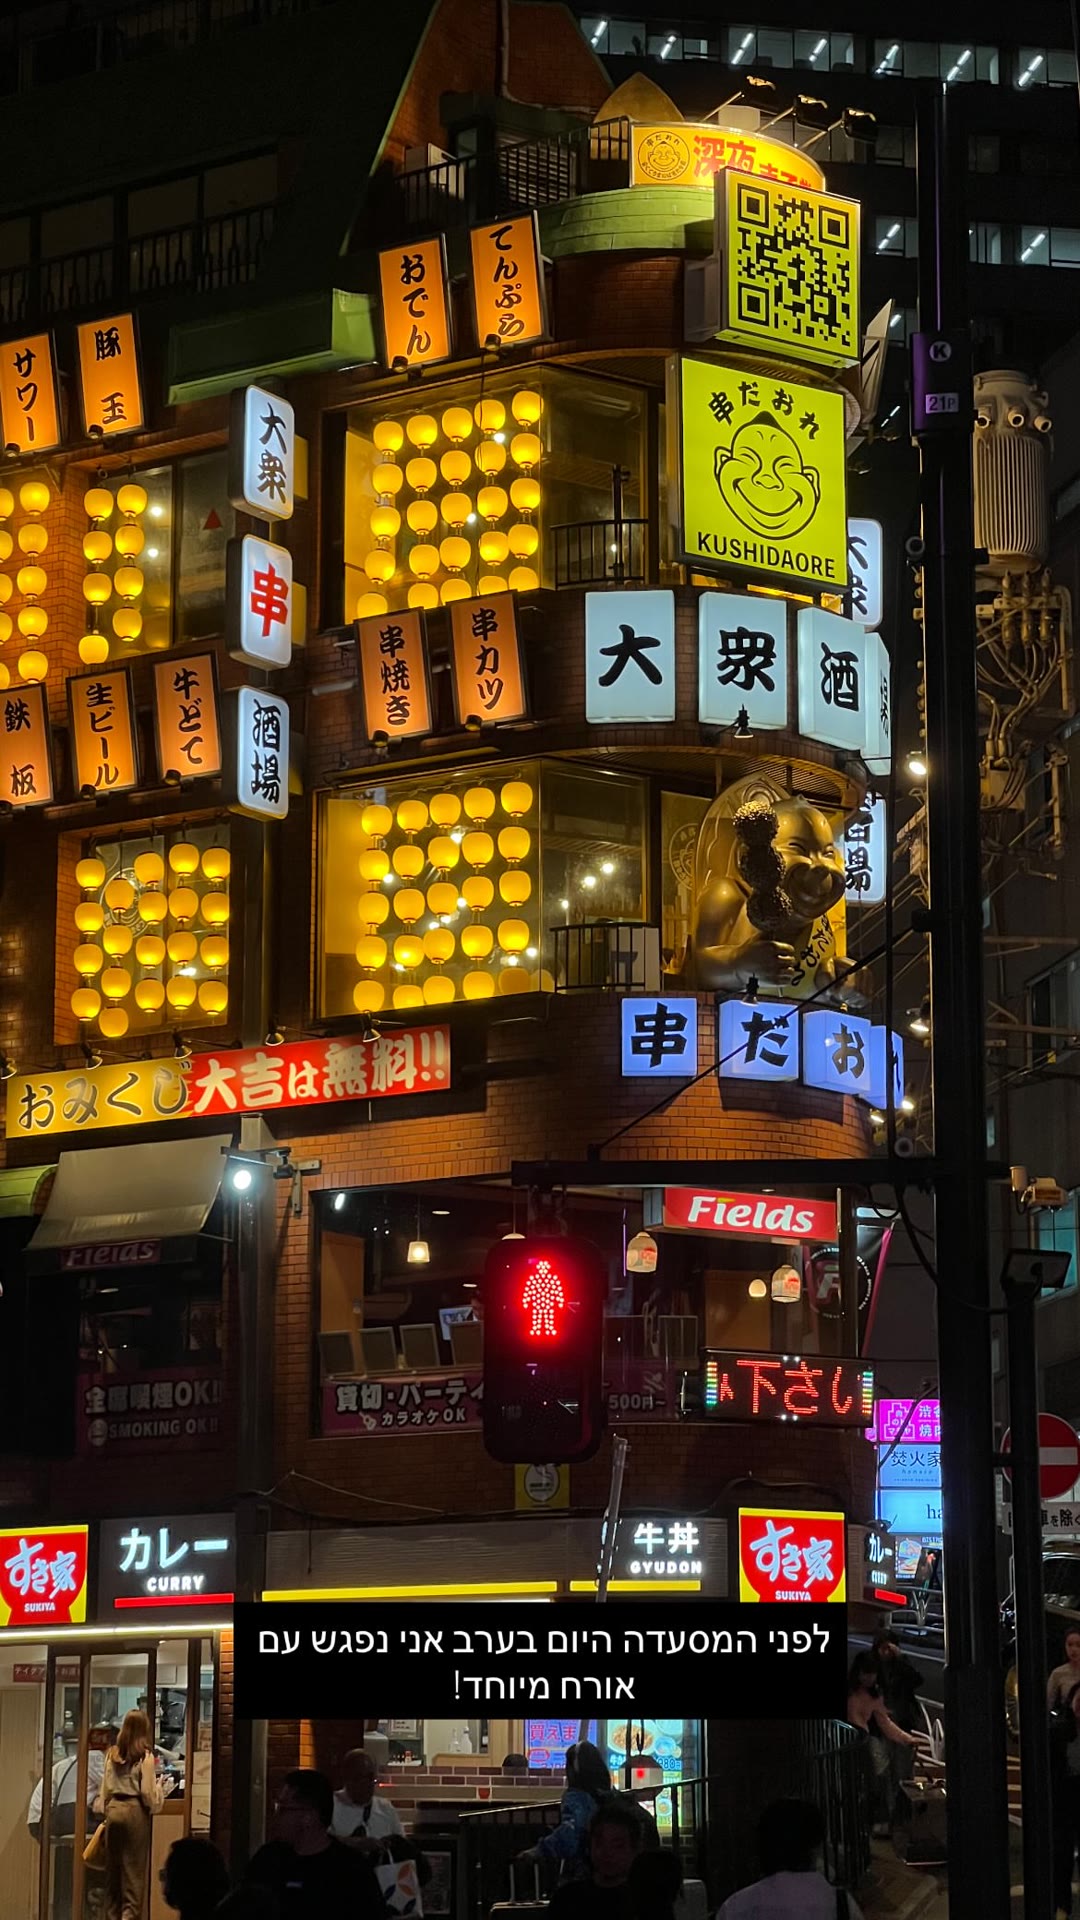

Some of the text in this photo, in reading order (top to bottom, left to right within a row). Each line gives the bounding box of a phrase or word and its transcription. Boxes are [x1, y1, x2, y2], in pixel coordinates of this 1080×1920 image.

[400, 254, 431, 356] おでん
[489, 225, 525, 336] てんぷら
[94, 327, 127, 424] 豚玉
[932, 344, 947, 360] K
[12, 348, 37, 441] サワー
[708, 381, 820, 440] 串だおれ
[257, 402, 287, 504] 大衆
[697, 532, 836, 579] KUSHIDAORE
[249, 562, 289, 637] 串
[379, 625, 411, 726] 串焼き
[471, 608, 504, 710] 串カツ
[4, 698, 37, 798] 鉄板
[86, 682, 119, 788] 生ビール
[173, 667, 203, 765] 牛どて
[250, 698, 282, 804] 酒場
[18, 1030, 446, 1130] おみくじ 大吉は無料!!
[687, 1195, 815, 1233] Fields
[109, 1419, 181, 1440] SMOKING
[4, 1538, 76, 1600] すき家
[119, 1527, 229, 1572] カレー
[630, 1560, 702, 1575] GYUDON
[633, 1521, 700, 1555] 牛丼
[749, 1519, 834, 1588] すき家
[869, 1532, 893, 1563] カレー
[24, 1602, 56, 1612] SUKIYA
[147, 1575, 205, 1592] CURRY
[775, 1590, 812, 1601] SUKIYA
